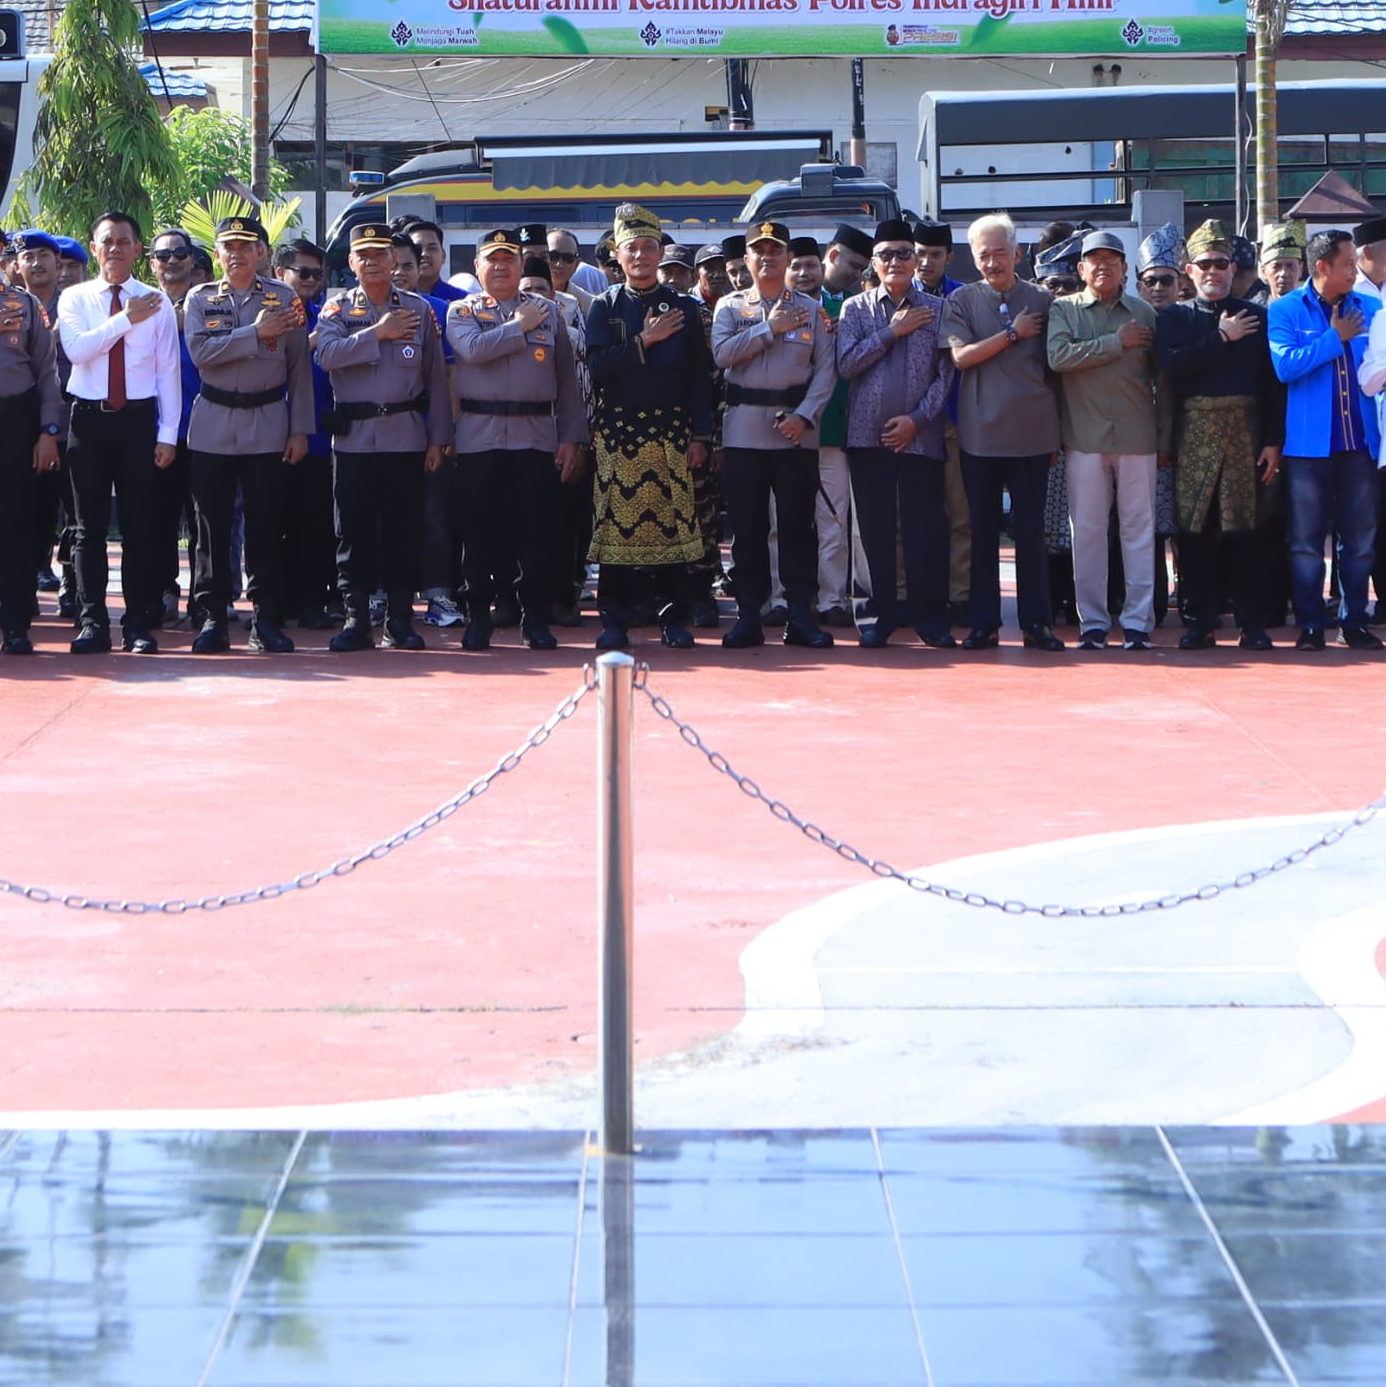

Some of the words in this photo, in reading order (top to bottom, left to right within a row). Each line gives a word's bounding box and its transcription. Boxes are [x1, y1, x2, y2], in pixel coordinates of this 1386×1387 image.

[696, 28, 724, 36] Melayu
[416, 37, 447, 46] Menjaga
[1148, 36, 1179, 44] Policing
